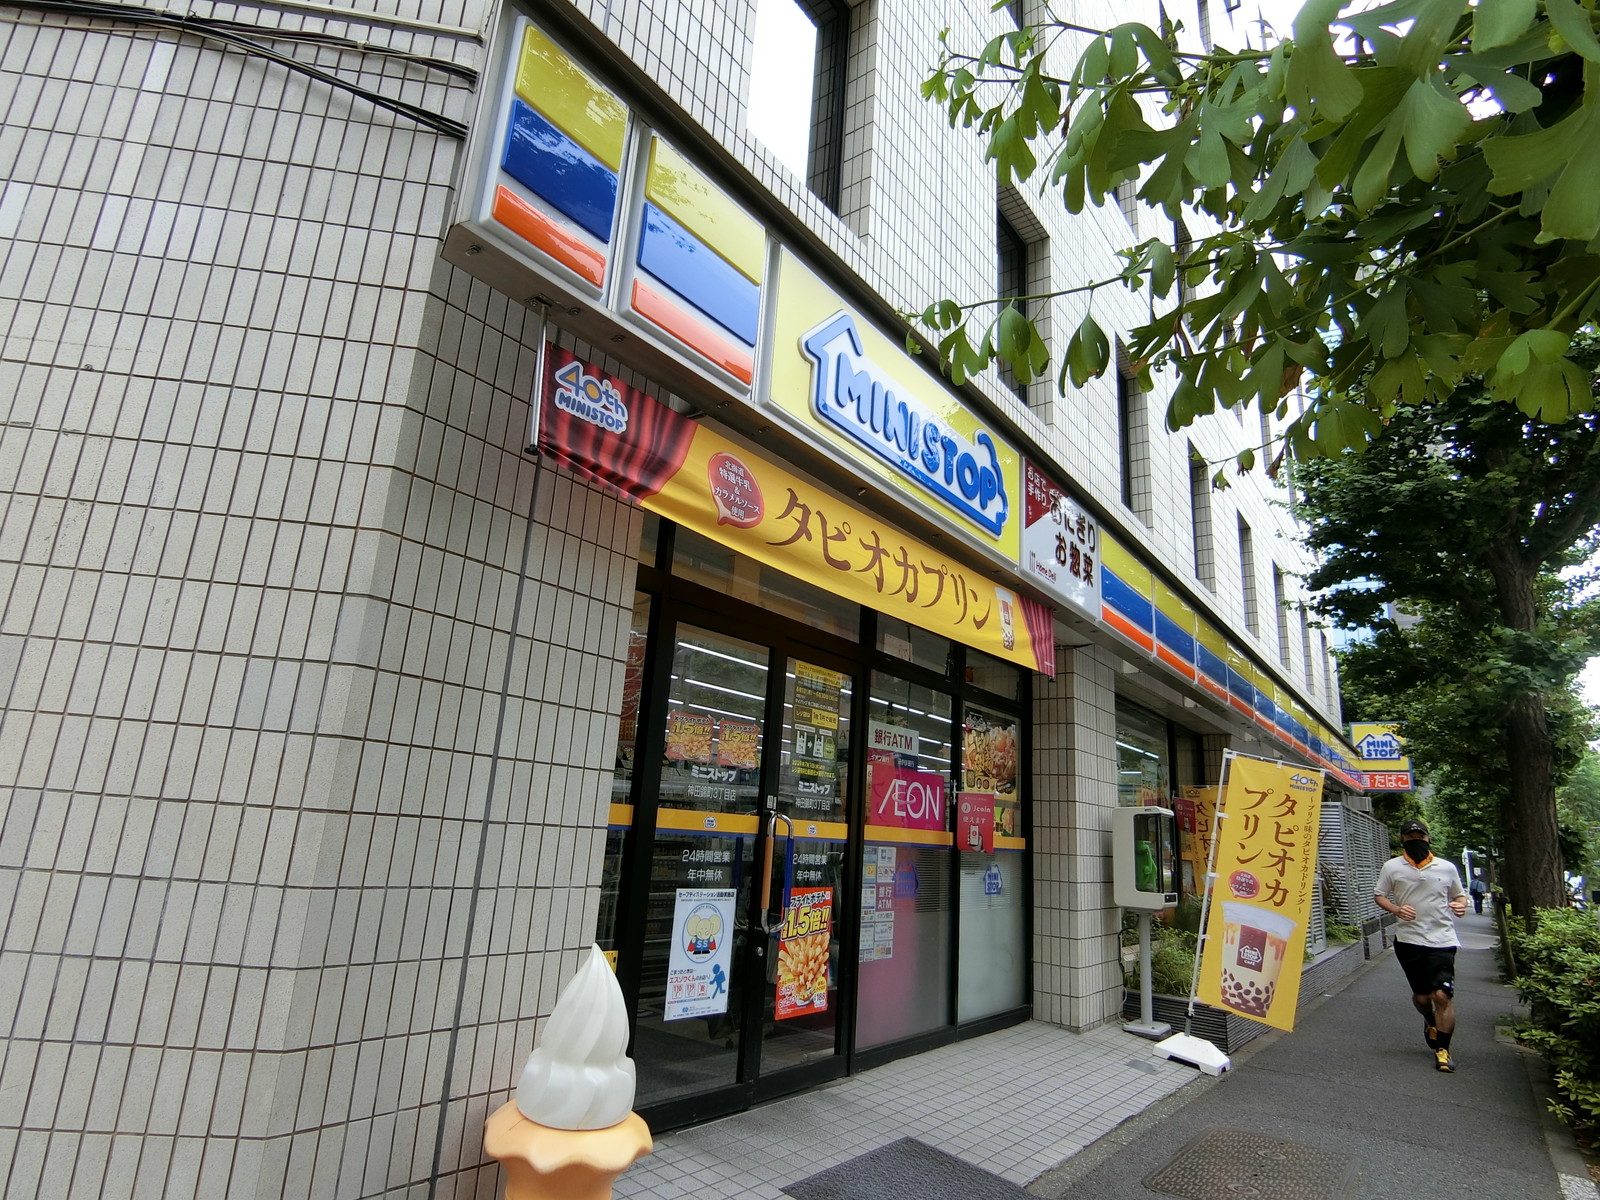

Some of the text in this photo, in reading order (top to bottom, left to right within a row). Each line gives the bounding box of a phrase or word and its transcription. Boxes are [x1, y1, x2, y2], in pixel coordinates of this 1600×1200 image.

[557, 363, 627, 418] 40th
[557, 391, 625, 431] MINISTOP
[835, 352, 997, 510] MINISTOP
[719, 467, 752, 492] 特選牛乳
[714, 486, 761, 515] カラメルソース
[731, 505, 745, 520] 使用
[1049, 489, 1096, 553] おにぎり
[765, 487, 992, 631] タピオカプリン
[1055, 531, 1094, 588] お惣菜
[874, 728, 913, 751] 銀行ATM
[1366, 740, 1393, 748] MINI
[1366, 749, 1396, 757] STOP
[691, 764, 737, 782] ミニストップ
[1289, 773, 1319, 787] 40th
[797, 780, 831, 795] ミニストップ
[1289, 783, 1317, 793] MINISTOP
[1236, 786, 1275, 865] プリン
[681, 849, 732, 864] 24時間営業
[792, 853, 828, 865] 24時間営業
[1257, 793, 1300, 907] タピオカ
[687, 868, 723, 882] 年中無休
[796, 870, 823, 881] 年中無休
[696, 940, 708, 948] SS
